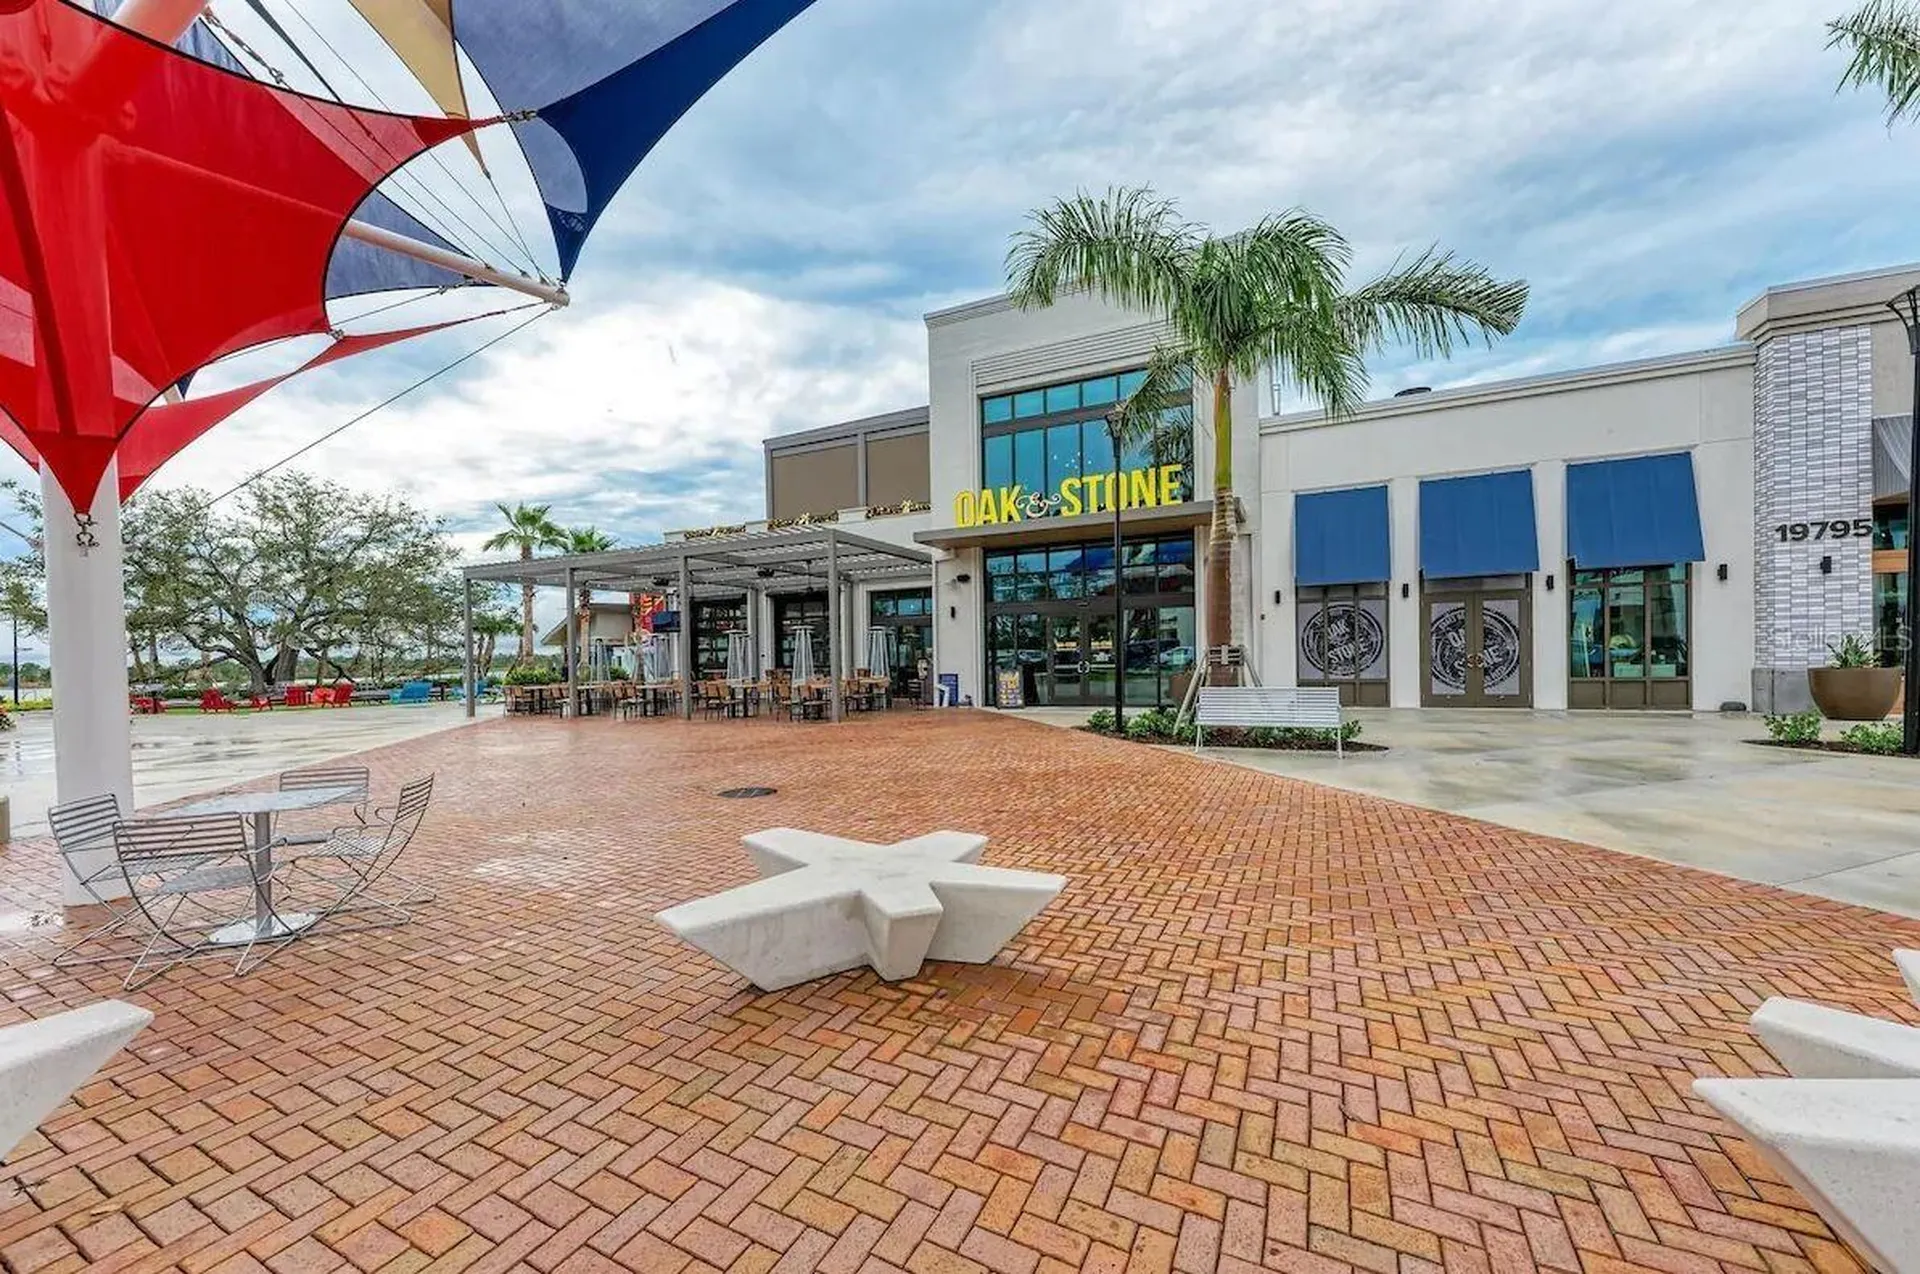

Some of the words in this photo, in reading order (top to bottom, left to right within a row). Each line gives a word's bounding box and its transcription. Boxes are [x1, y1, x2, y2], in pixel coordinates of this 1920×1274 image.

[954, 485, 1021, 527] OAK
[1015, 492, 1061, 518] &
[1060, 464, 1183, 517] STONE
[1775, 518, 1873, 542] 19795
